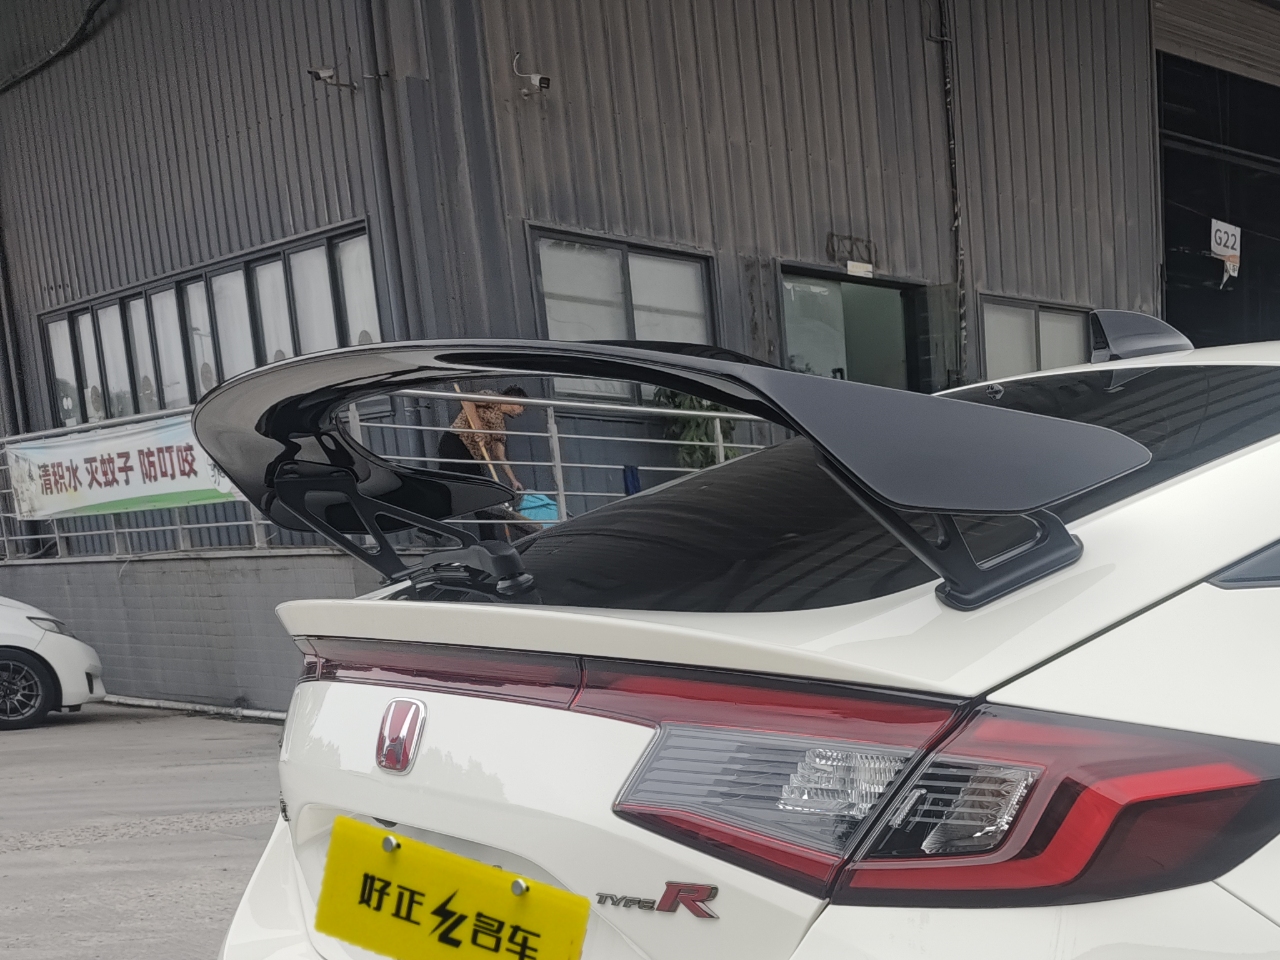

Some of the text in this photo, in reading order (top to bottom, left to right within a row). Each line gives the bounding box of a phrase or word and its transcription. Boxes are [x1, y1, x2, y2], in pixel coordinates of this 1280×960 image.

[1214, 228, 1237, 251] G22
[38, 442, 198, 495] 清积水 灭蚊子 防叮咬
[595, 880, 720, 920] TYPE R
